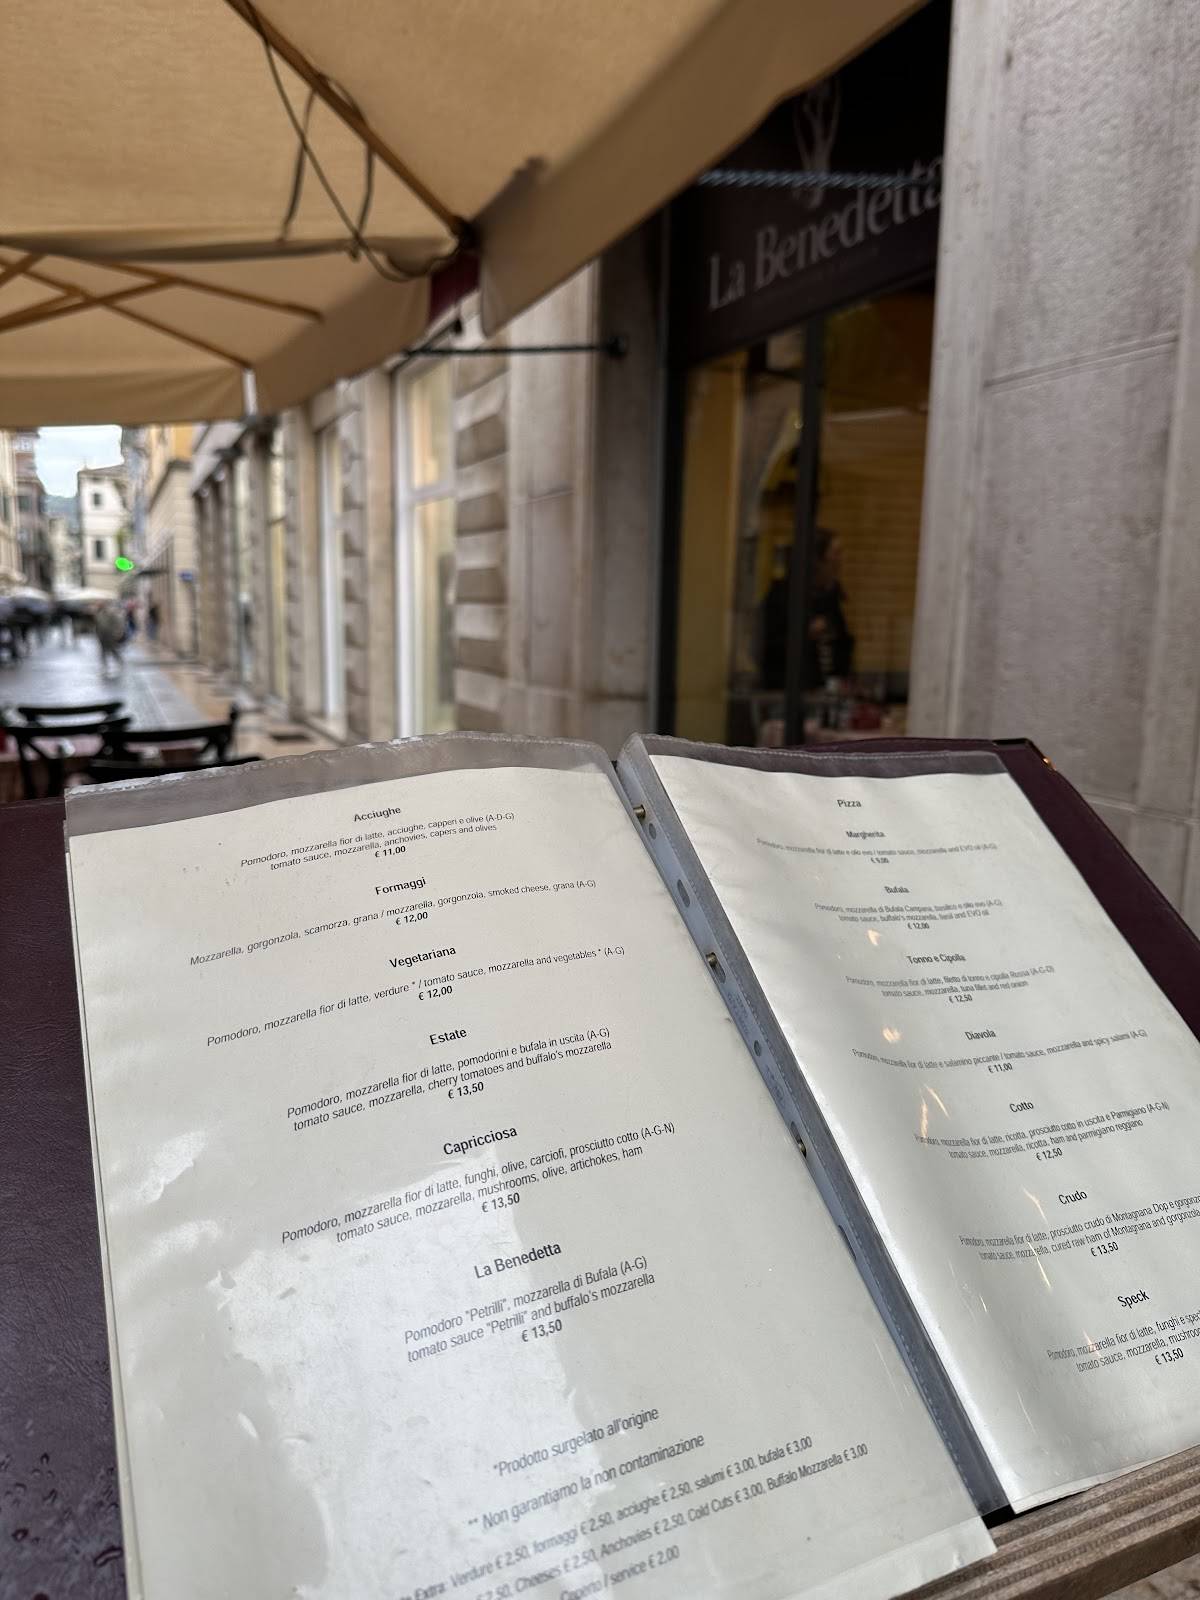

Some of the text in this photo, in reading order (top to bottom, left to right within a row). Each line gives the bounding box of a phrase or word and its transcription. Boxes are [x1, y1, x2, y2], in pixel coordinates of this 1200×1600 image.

[708, 251, 746, 312] La
[836, 799, 862, 808] Pizza
[354, 807, 401, 822] Acciughe
[240, 851, 289, 867] Pomodoro,
[291, 840, 338, 855] mozzarella
[339, 837, 353, 845] fior
[354, 835, 363, 843] di
[364, 831, 385, 841] latte,
[387, 824, 426, 836] acciughe,
[427, 819, 458, 829] capperi
[465, 816, 484, 824] olive
[485, 812, 515, 823] (A-D-G)
[270, 824, 497, 871] tomato sauce, mozzarella, anchovies, capers and olives
[382, 845, 406, 856] 11,00
[375, 876, 426, 895] Formaggi
[190, 879, 597, 966] Mozzarella, gorgonzola, scamorza, grana mozzarella, gorgonzola, smoked cheese, grana (A-G)
[403, 911, 428, 923] 12,00
[389, 947, 456, 968] Vegetariana
[207, 946, 625, 1047] Pomodoro, mozzarella fior di latte, verdure tomato sauce, mozzarella and vegetables (A-G)
[427, 985, 453, 999] 12,00
[429, 1029, 467, 1045] Estate
[964, 1029, 997, 1041] Diavola
[287, 1027, 610, 1119] Pomodoro, mozzarella fior di latte, pomodorini e bufala in uscita (A-G)
[993, 1062, 1013, 1072] 11,00
[294, 1041, 612, 1132] tomato sauce, mozzarella, cherry tomatoes and buffalo's mozzarella
[457, 1081, 484, 1097] 13,50
[1009, 1102, 1034, 1113] Cotto
[443, 1127, 518, 1155] Capricciosa
[1042, 1147, 1063, 1160] 12,50
[282, 1122, 675, 1244] Pomodoro, mozzarella fior di latte, funghi, olive, carciofi, prosciutto cotto (A-G-N)
[336, 1146, 643, 1243] tomato sauce, mozzarella, mushrooms, olive, artichokes, ham
[491, 1192, 520, 1210] 13,50
[1058, 1190, 1088, 1205] Crudo
[1097, 1241, 1119, 1255] 13,50
[474, 1244, 562, 1279] La Benedetta
[404, 1315, 464, 1345] Pomodoro
[513, 1280, 571, 1307] mozzarella
[573, 1274, 584, 1289] di
[584, 1266, 618, 1285] Bufala
[620, 1255, 648, 1276] (A-G)
[1117, 1289, 1150, 1309] Speck
[407, 1340, 448, 1363] tomato
[450, 1327, 484, 1348] sauce
[530, 1302, 552, 1321] and
[600, 1273, 656, 1299] mozzarella
[1184, 1312, 1200, 1325] spec
[531, 1318, 563, 1339] 13,50
[1168, 1327, 1200, 1345] mushroo
[1161, 1347, 1184, 1363] 13,50
[551, 1428, 605, 1457] surgelato
